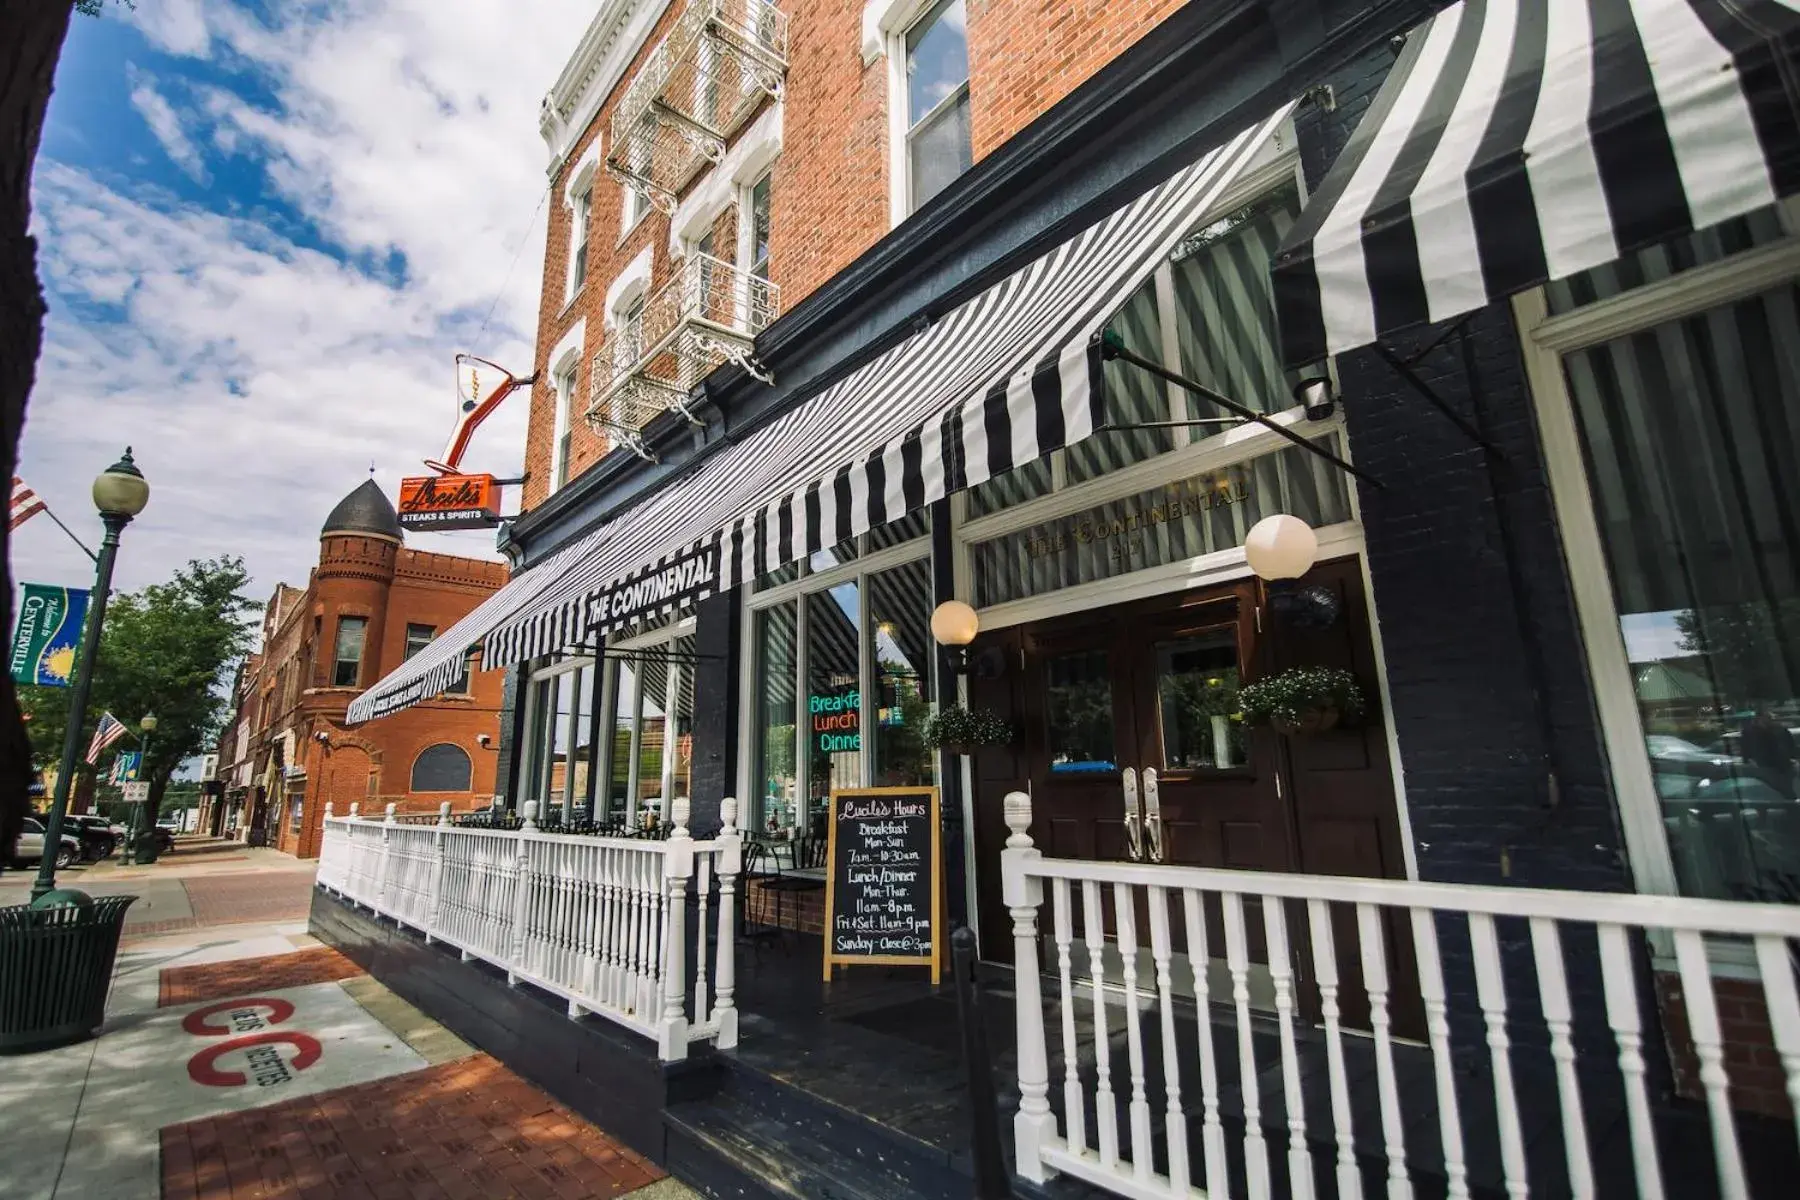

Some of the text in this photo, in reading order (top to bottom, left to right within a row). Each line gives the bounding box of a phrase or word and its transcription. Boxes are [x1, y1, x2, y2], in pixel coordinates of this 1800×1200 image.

[402, 510, 482, 522] STEAKS & SPIRITS
[1073, 479, 1249, 544] CONTINENTAL
[587, 551, 714, 626] THE CONTINENTAL
[43, 597, 59, 630] Welcome
[10, 596, 44, 674] CENTERVILLE
[810, 690, 861, 713] Breakfa
[814, 710, 858, 731] Lunch
[821, 733, 861, 751] Dinne
[838, 800, 926, 820] Lucile's Hours
[859, 820, 909, 836] Breakfast
[864, 836, 904, 849] Mon-Sun
